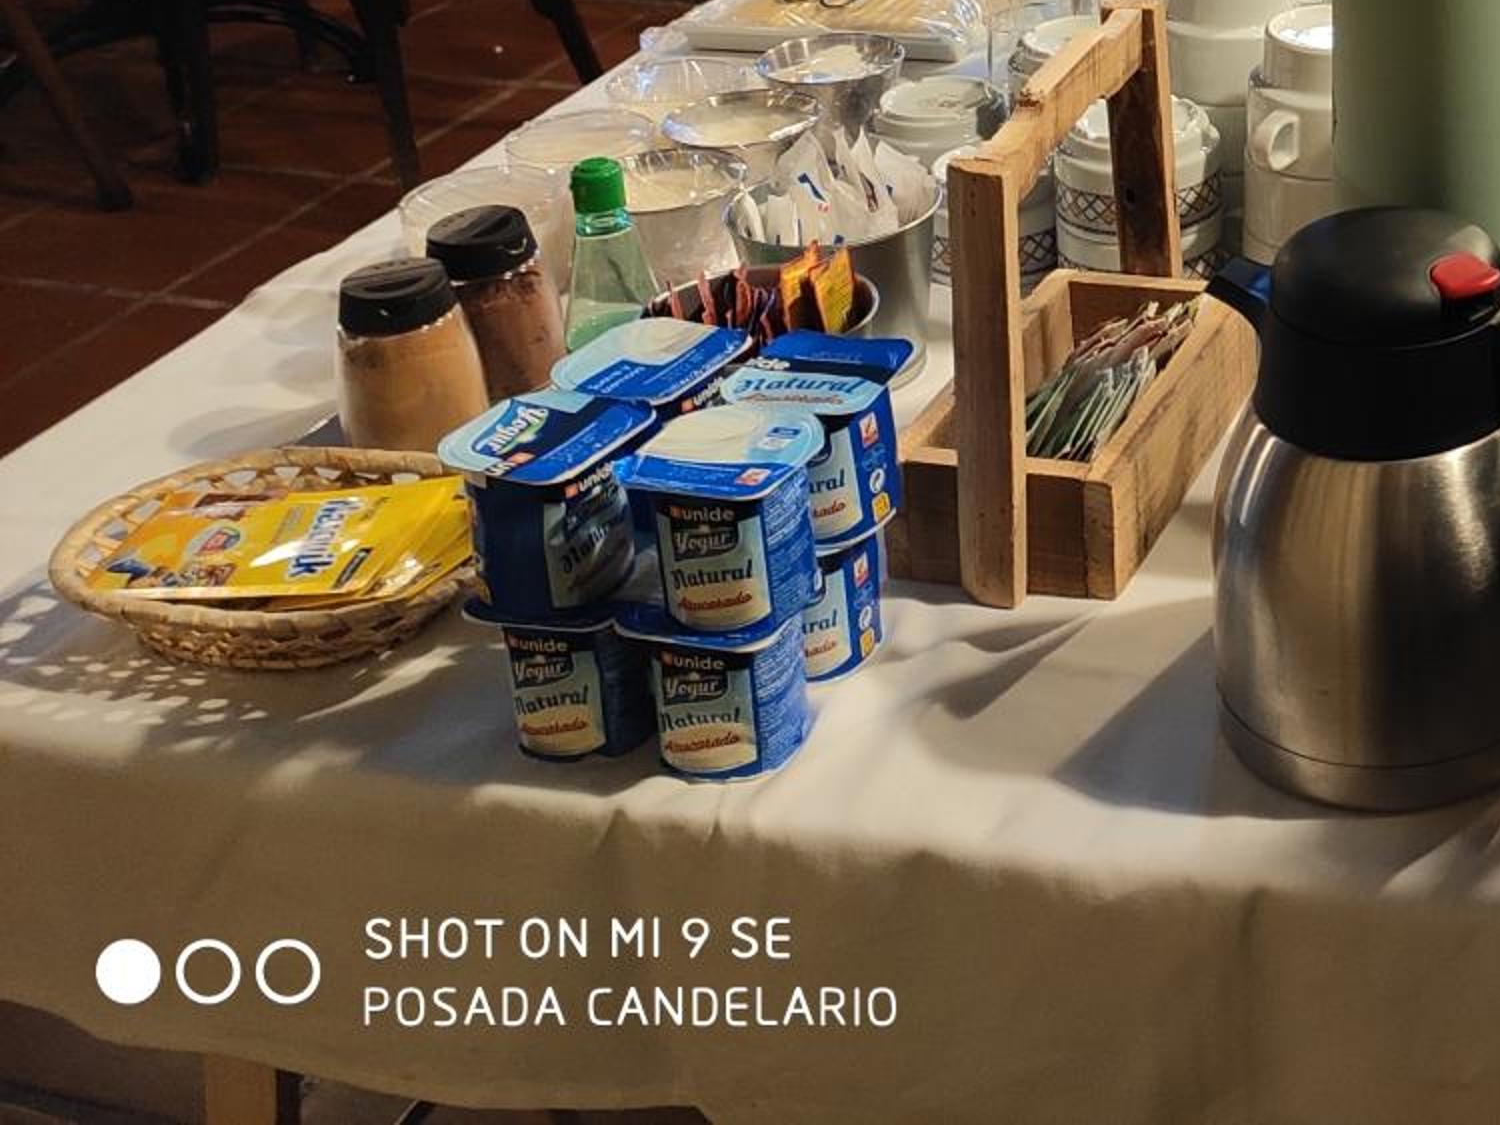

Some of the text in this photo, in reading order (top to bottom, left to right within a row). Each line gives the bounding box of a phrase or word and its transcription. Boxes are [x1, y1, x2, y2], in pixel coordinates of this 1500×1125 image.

[736, 376, 867, 393] Natural
[674, 531, 733, 555] Yogur
[671, 559, 753, 590] Natural
[514, 661, 568, 683] Yogur
[513, 684, 589, 716] Natural
[665, 677, 719, 700] Yogur
[660, 707, 741, 733] Natural
